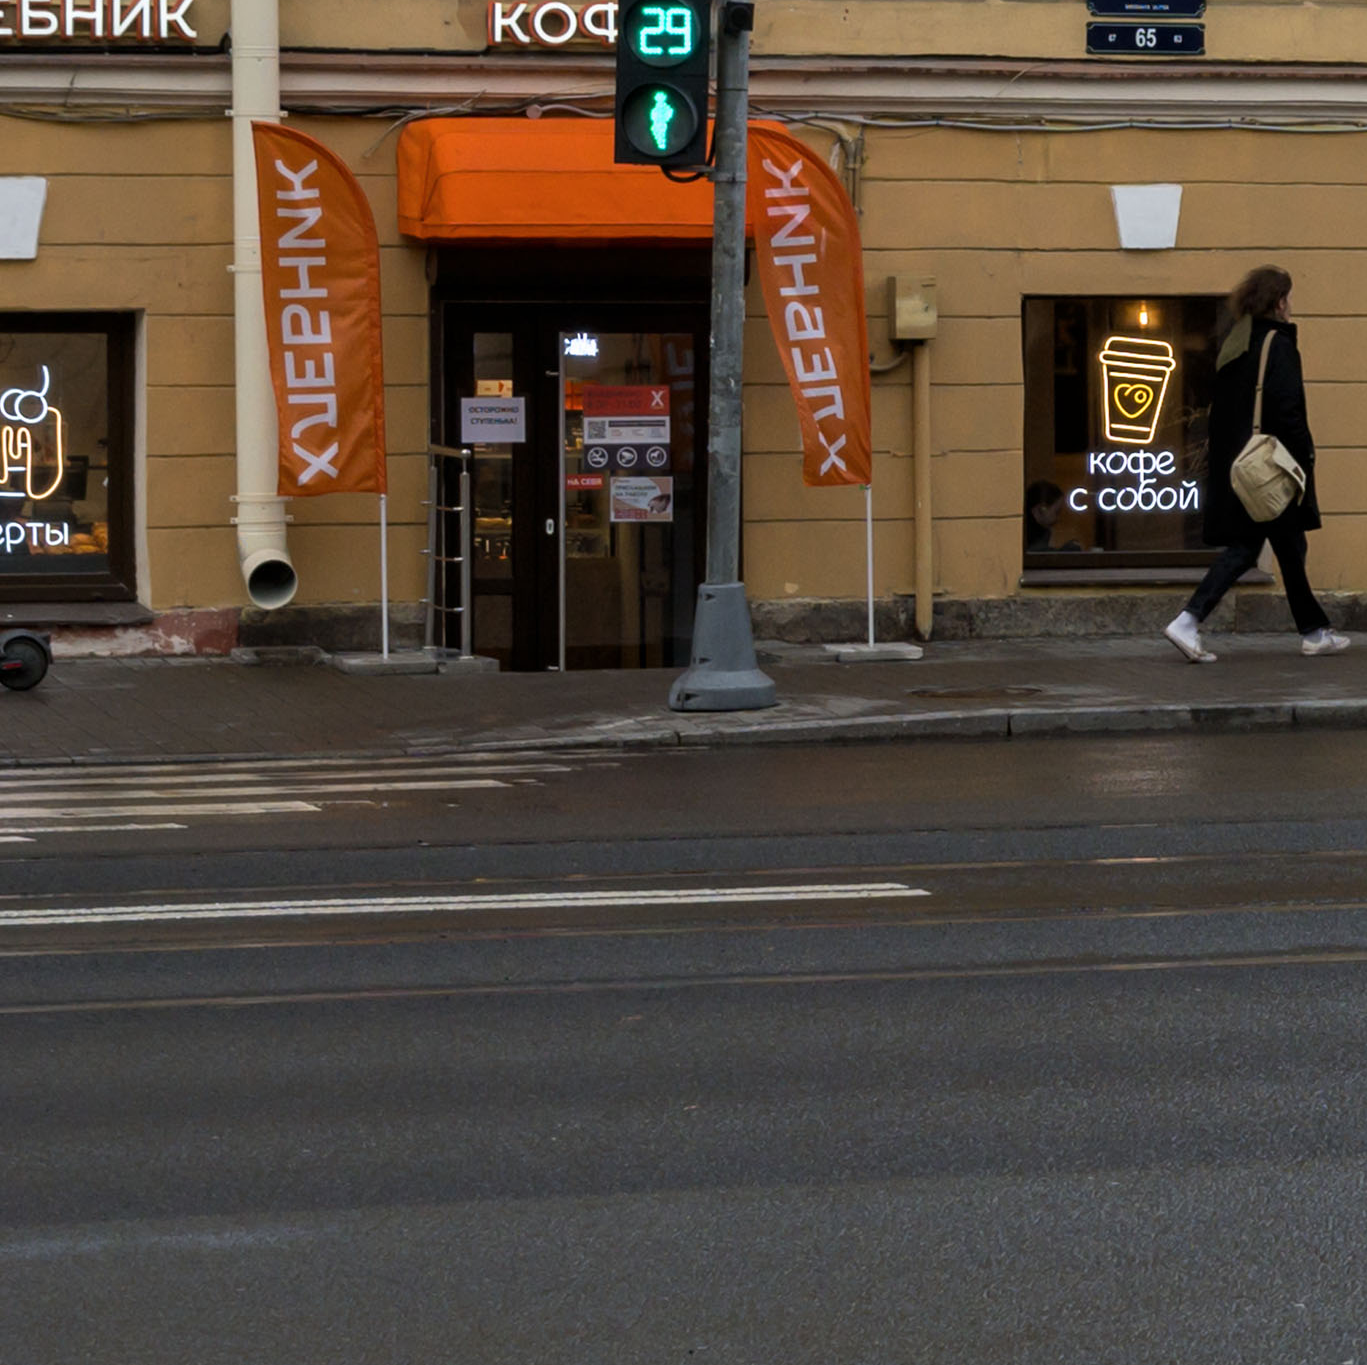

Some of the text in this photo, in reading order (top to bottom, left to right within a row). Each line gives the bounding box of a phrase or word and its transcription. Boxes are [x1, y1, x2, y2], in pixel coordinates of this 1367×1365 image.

[487, 1, 619, 45] КОФ
[639, 6, 692, 55] 29
[1135, 28, 1157, 47] 65
[1089, 449, 1177, 483] кофе
[1068, 477, 1199, 511] с собой
[0, 522, 69, 553] рты
